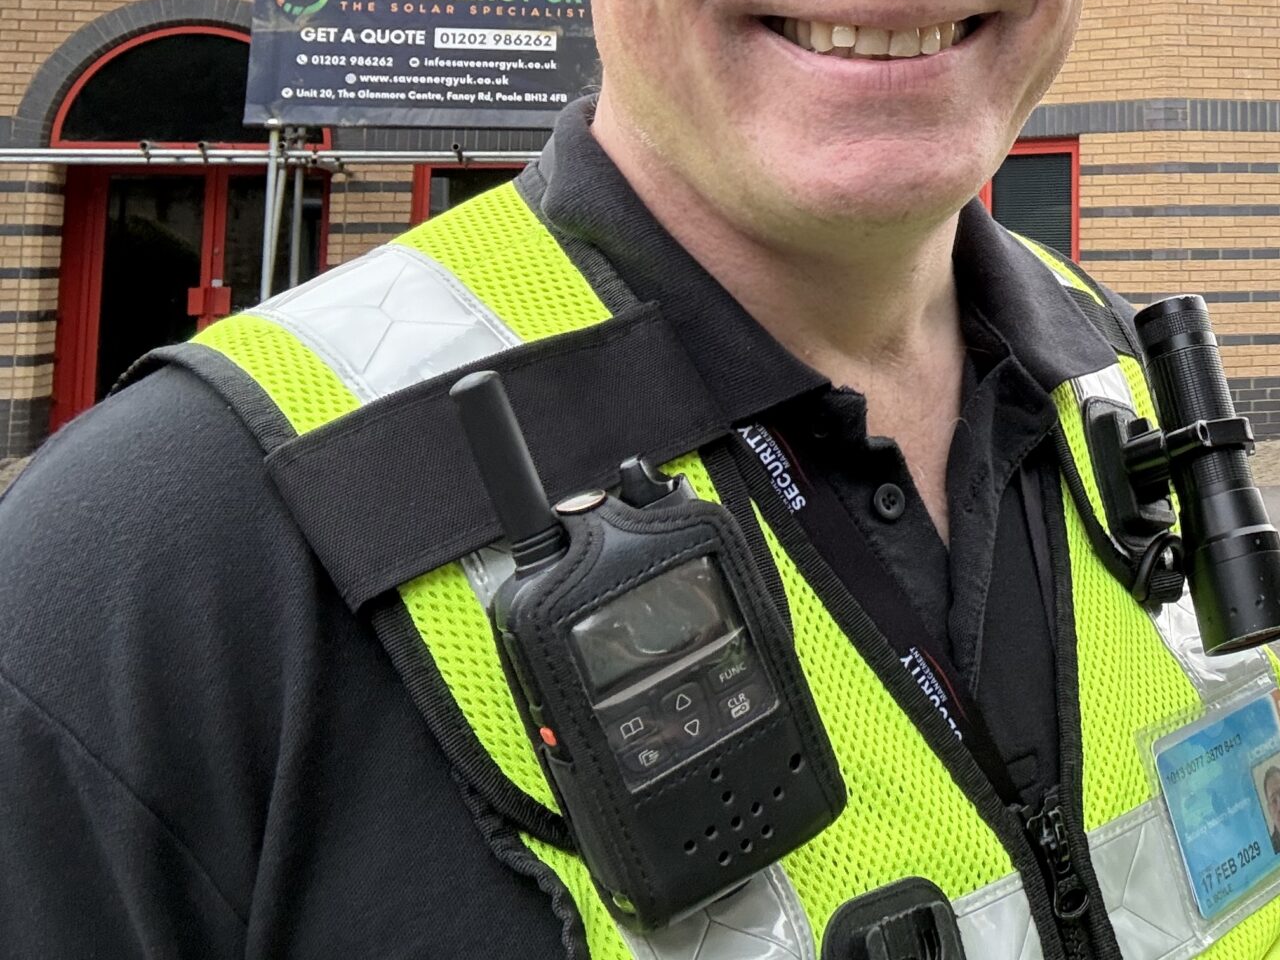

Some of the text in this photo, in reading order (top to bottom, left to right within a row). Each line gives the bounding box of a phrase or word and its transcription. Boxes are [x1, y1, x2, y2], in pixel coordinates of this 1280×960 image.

[339, 0, 585, 19] THE SOLAR SPECIALIST
[300, 27, 553, 47] GET A QUOTE 01202 986262
[311, 55, 394, 67] 01202 986262
[359, 74, 510, 87] www.saveenergyuk.co.uk
[296, 88, 317, 98] Unit
[337, 89, 356, 99] The
[495, 92, 522, 102] Poole
[524, 93, 548, 103] BH12
[737, 425, 807, 511] SECURITY
[718, 660, 747, 683] FUNC
[909, 646, 948, 702] MANAGEMENT
[727, 692, 747, 709] CLR
[1214, 856, 1238, 885] FEB
[1237, 841, 1261, 869] 2029
